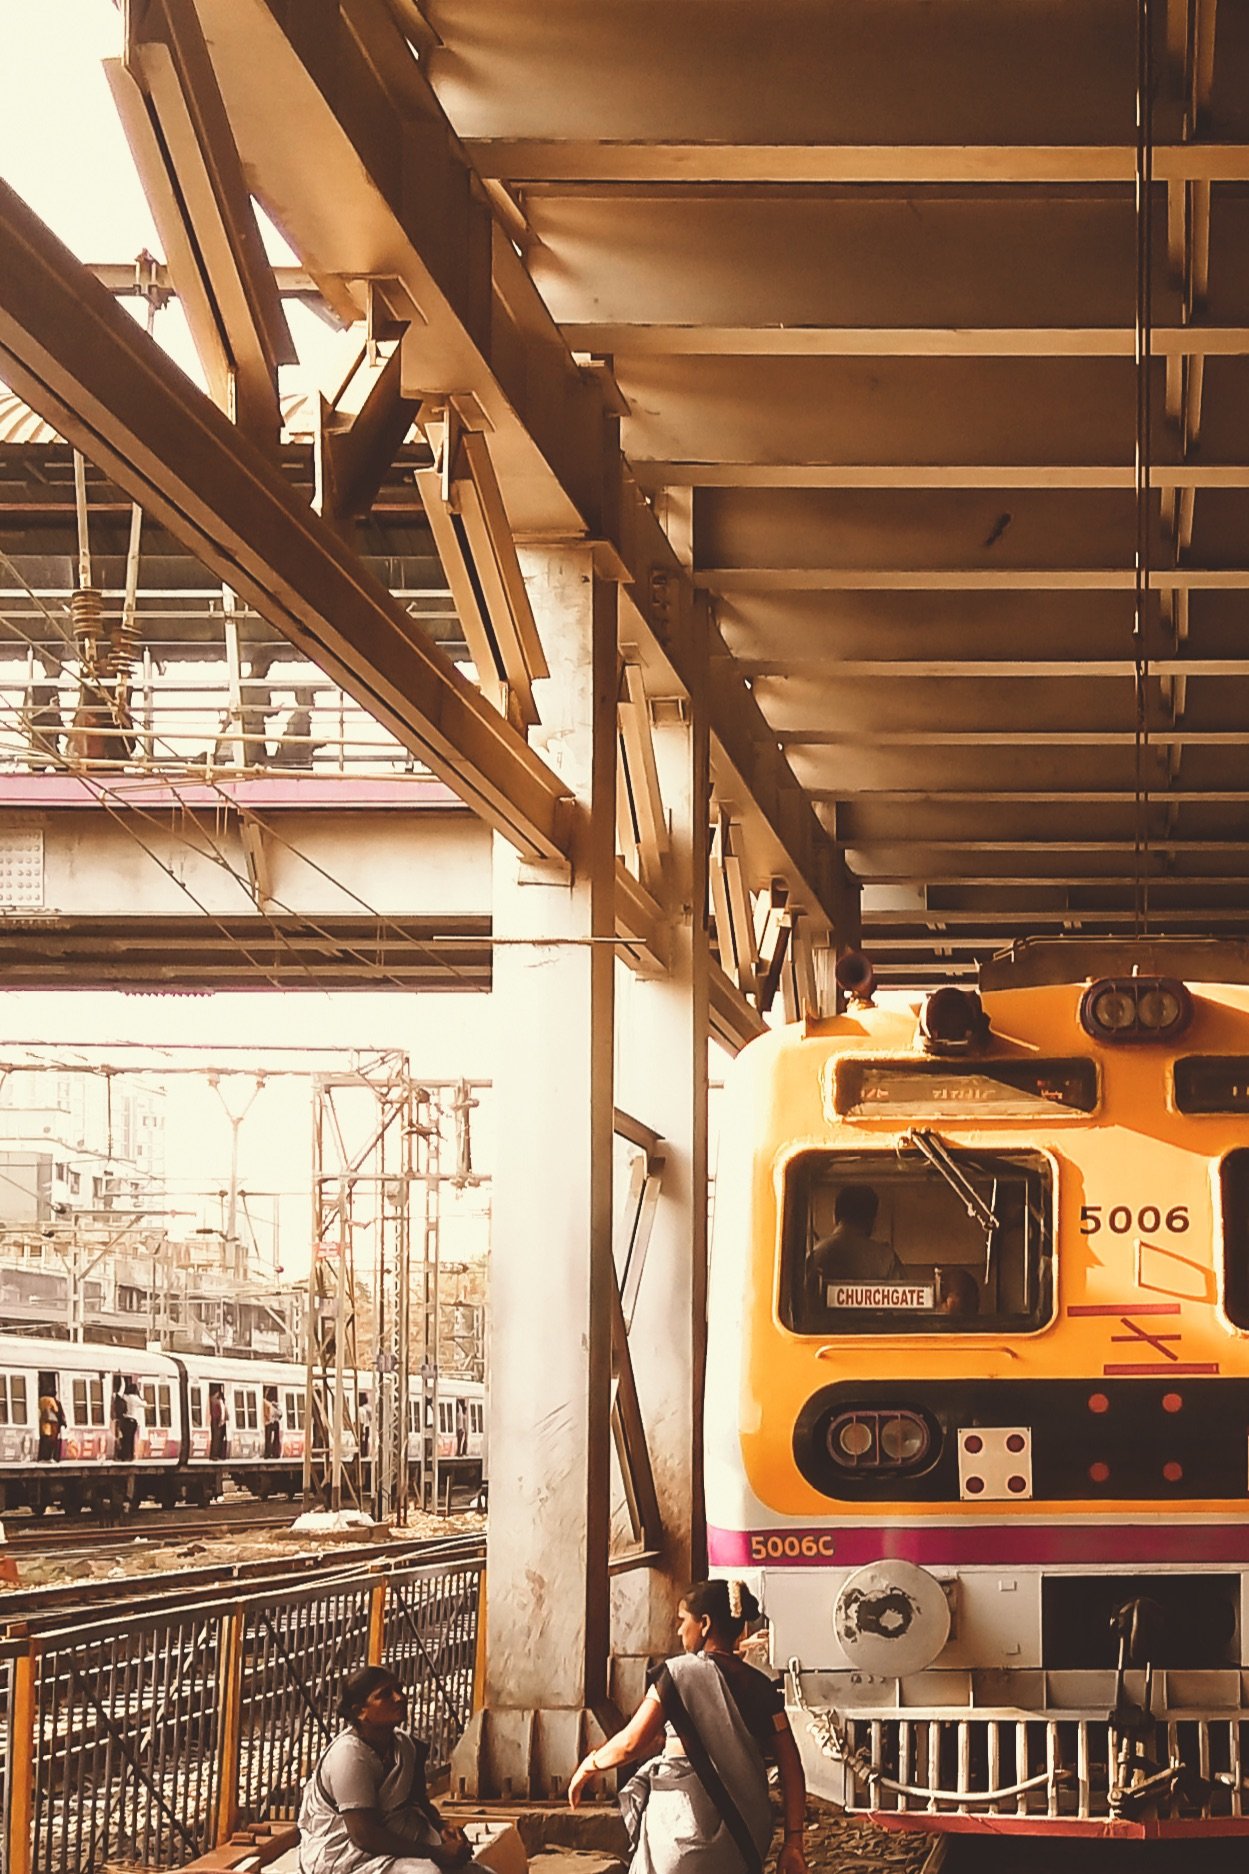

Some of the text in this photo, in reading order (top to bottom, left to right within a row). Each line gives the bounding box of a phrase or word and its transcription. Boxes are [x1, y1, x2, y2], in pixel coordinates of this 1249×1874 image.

[1080, 1206, 1190, 1235] 5006
[836, 1288, 925, 1306] CHURCHGATE
[751, 1536, 834, 1559] 5006C
